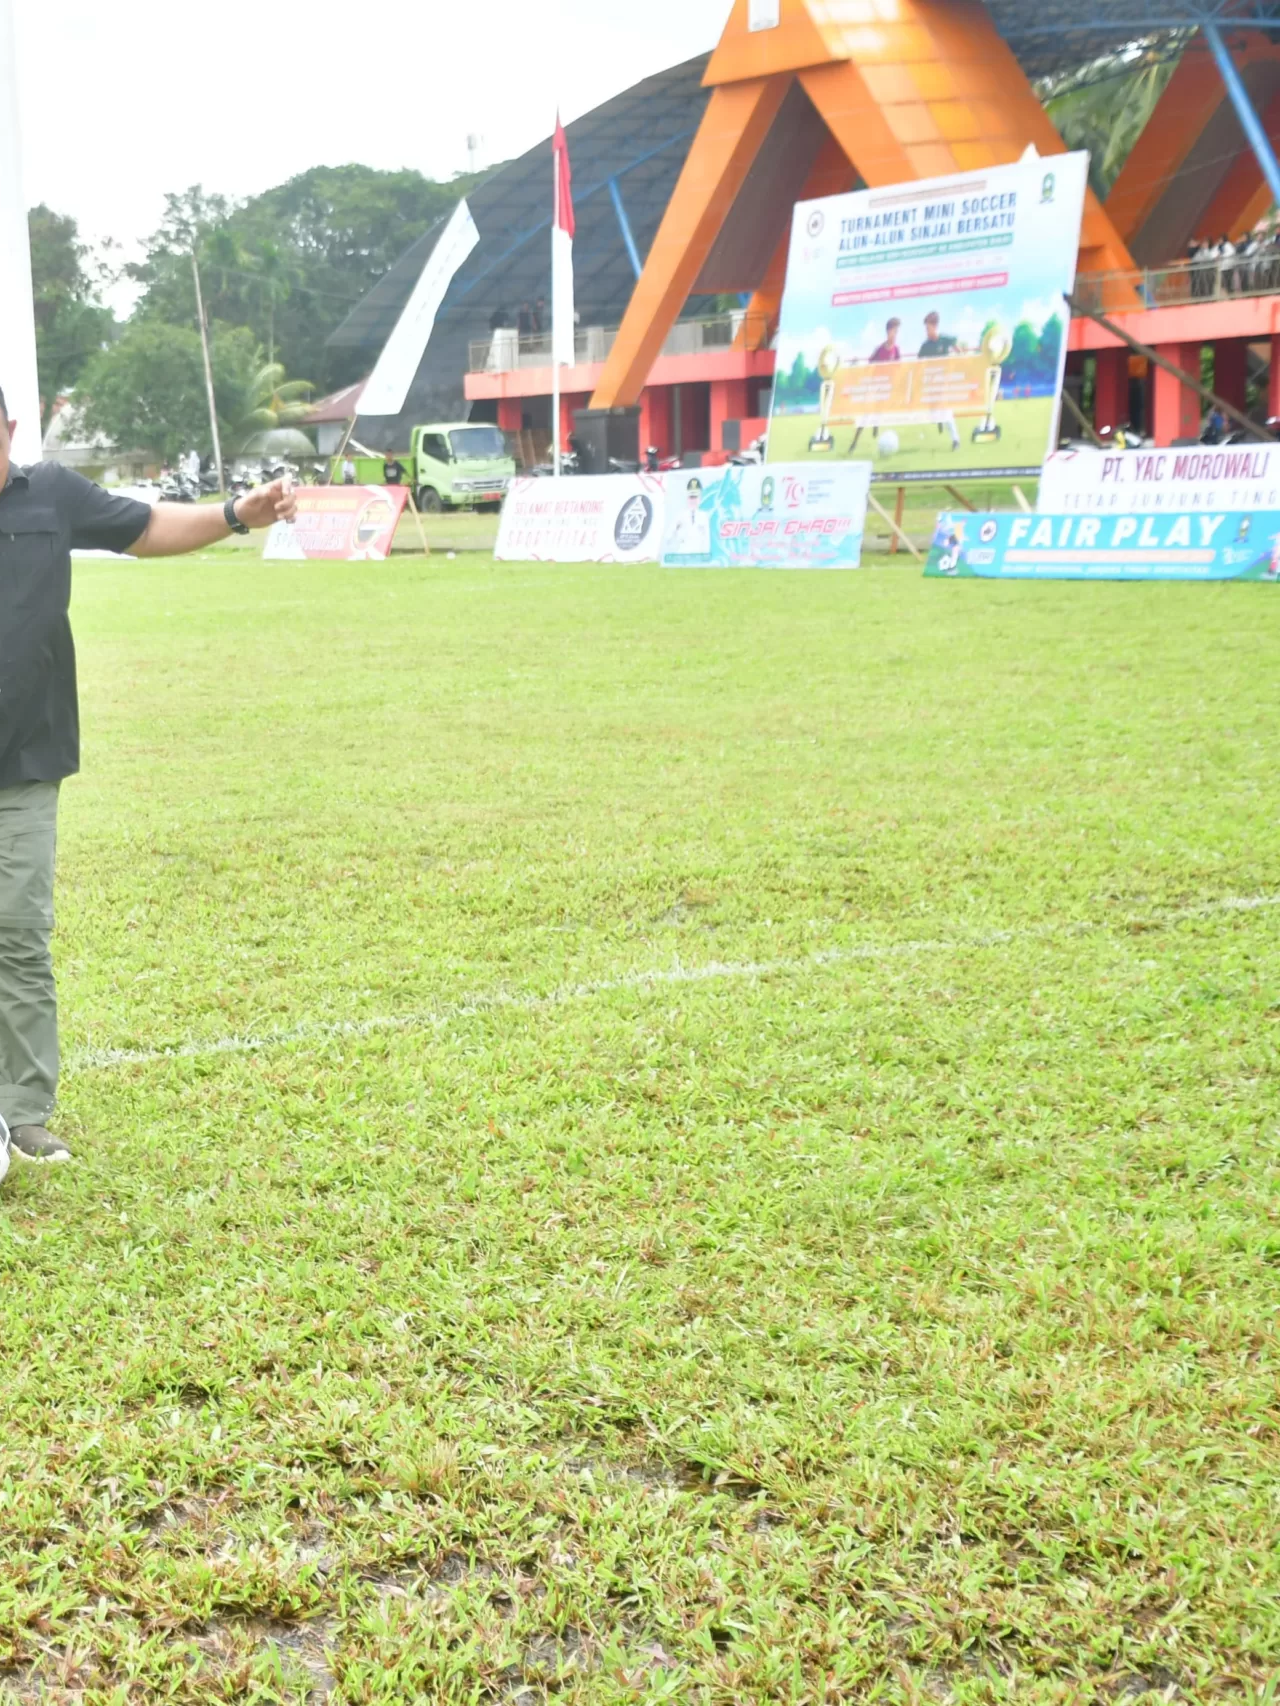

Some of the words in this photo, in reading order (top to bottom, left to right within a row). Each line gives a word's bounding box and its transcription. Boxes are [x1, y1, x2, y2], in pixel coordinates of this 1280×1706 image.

[840, 208, 918, 235] TURNAMENT
[924, 202, 955, 222] MINI
[961, 191, 1017, 215] SOCCER
[838, 229, 905, 252] ALUN-ALUN
[910, 221, 952, 242] SINJAI
[957, 211, 1015, 234] BERSATU
[1101, 456, 1124, 483] PT.
[1134, 454, 1167, 481] YAC
[1171, 451, 1271, 481] MOROWALI
[1064, 493, 1118, 509] TETAP
[1130, 491, 1216, 508] JUNJUNG
[720, 520, 780, 538] SINJAI
[1007, 517, 1102, 548] FAIR
[1110, 515, 1227, 547] PLAY
